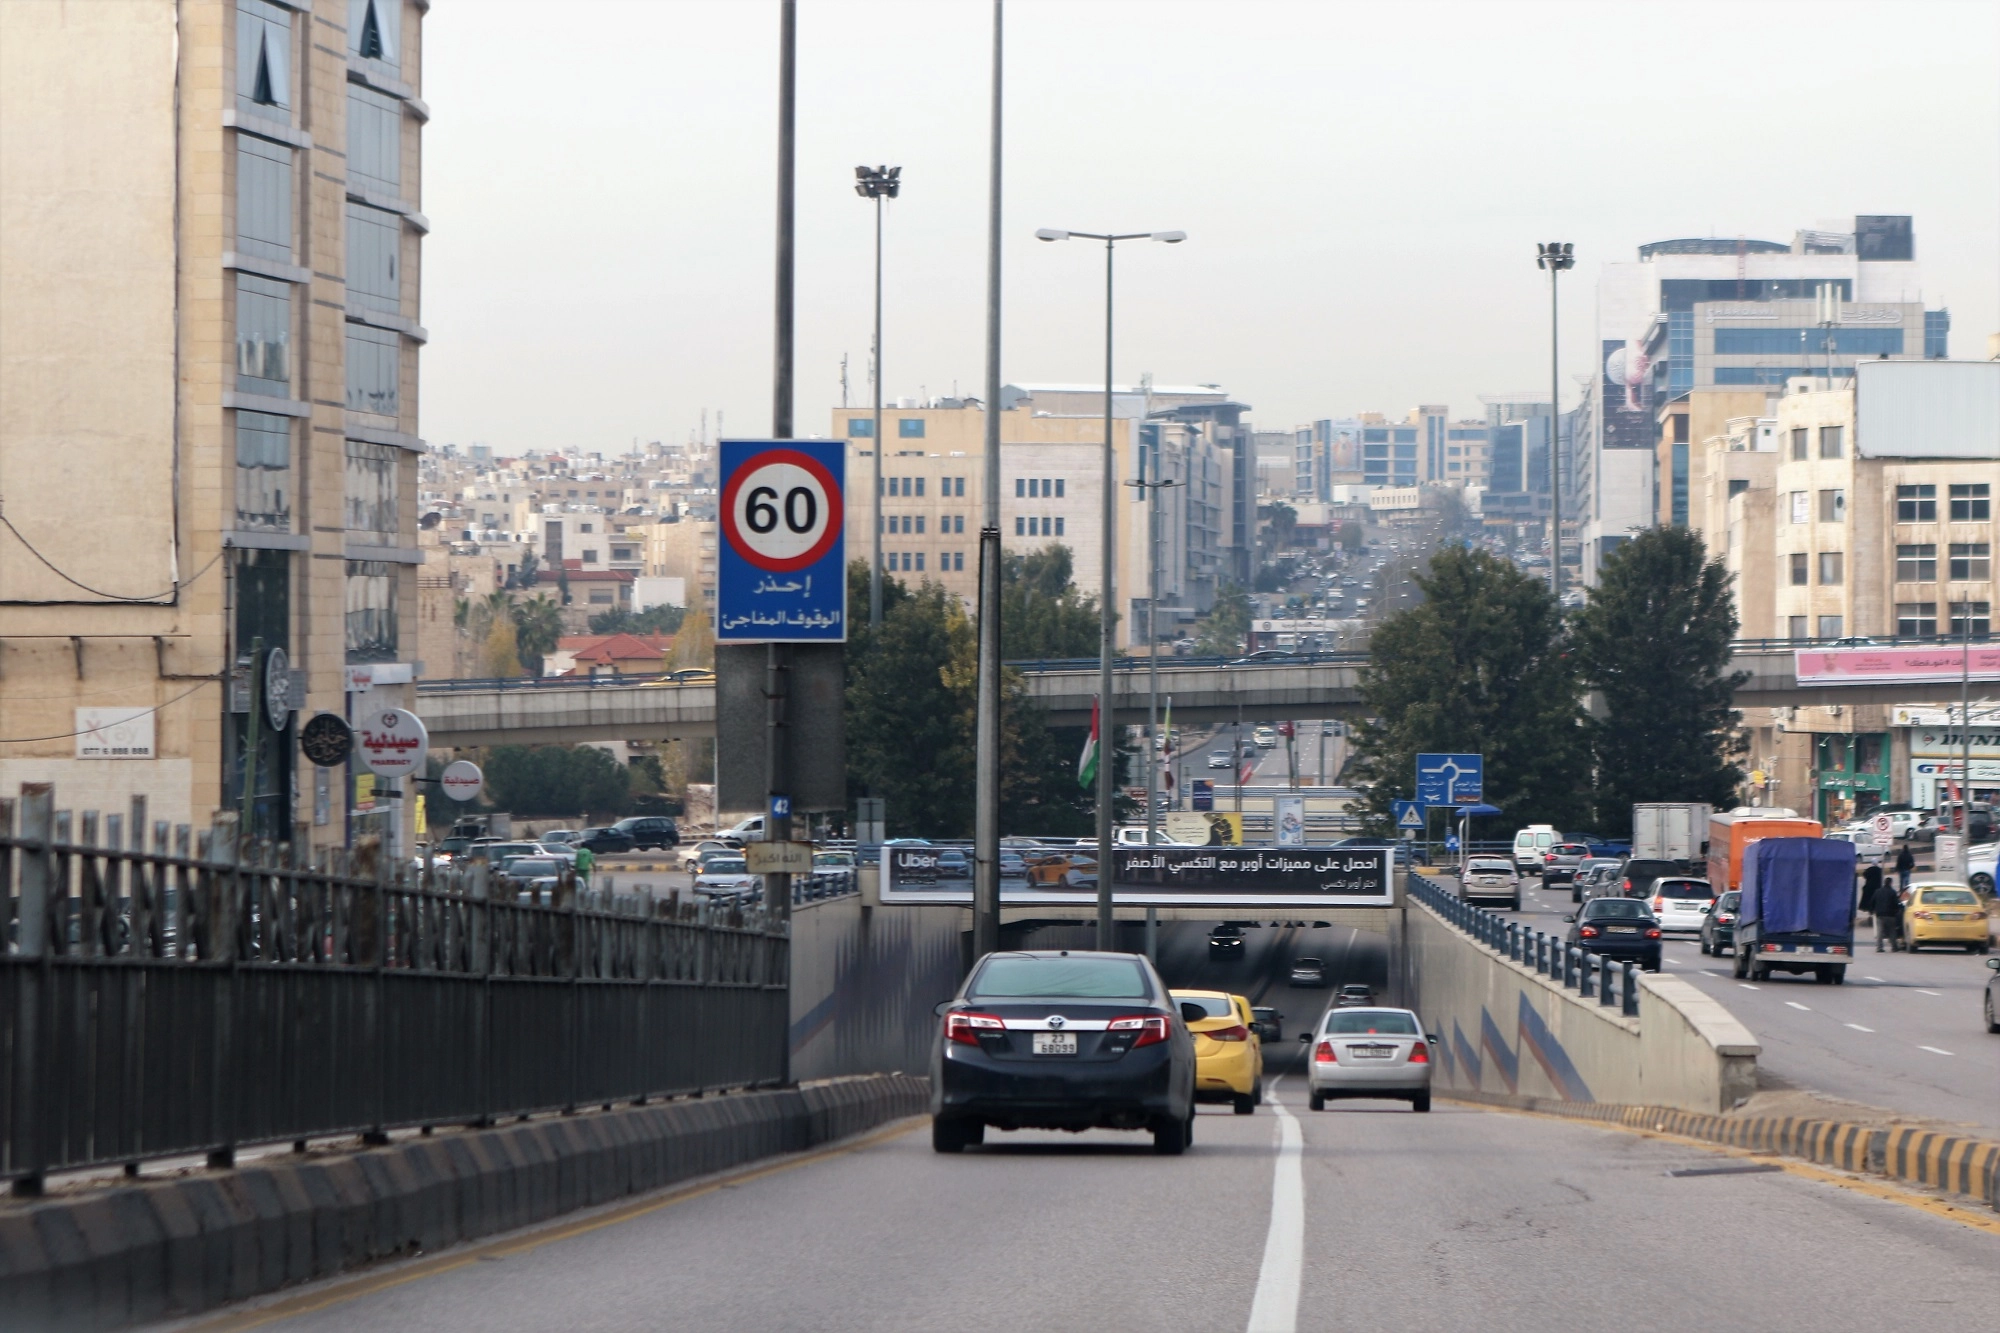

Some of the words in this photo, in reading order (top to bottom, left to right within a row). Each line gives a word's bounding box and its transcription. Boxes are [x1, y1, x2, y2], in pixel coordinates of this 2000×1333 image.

[745, 486, 818, 535] 60
[752, 574, 812, 598] إحذر
[721, 609, 786, 630] المفاجئ
[786, 608, 841, 629] الوقوف
[362, 730, 420, 754] صيدلية
[370, 758, 412, 766] PHARMACY
[444, 776, 480, 787] صيدلية
[774, 799, 789, 815] 42
[782, 851, 802, 864] الله
[898, 853, 938, 868] Uber
[1124, 854, 1166, 872] الأصفر
[1168, 855, 1216, 874] التكسي
[1219, 859, 1238, 872] مع
[1240, 853, 1263, 872] أوبر
[1265, 856, 1312, 873] مميزات
[1313, 856, 1340, 873] على
[1342, 857, 1378, 873] احصل
[1051, 1033, 1066, 1044] 23
